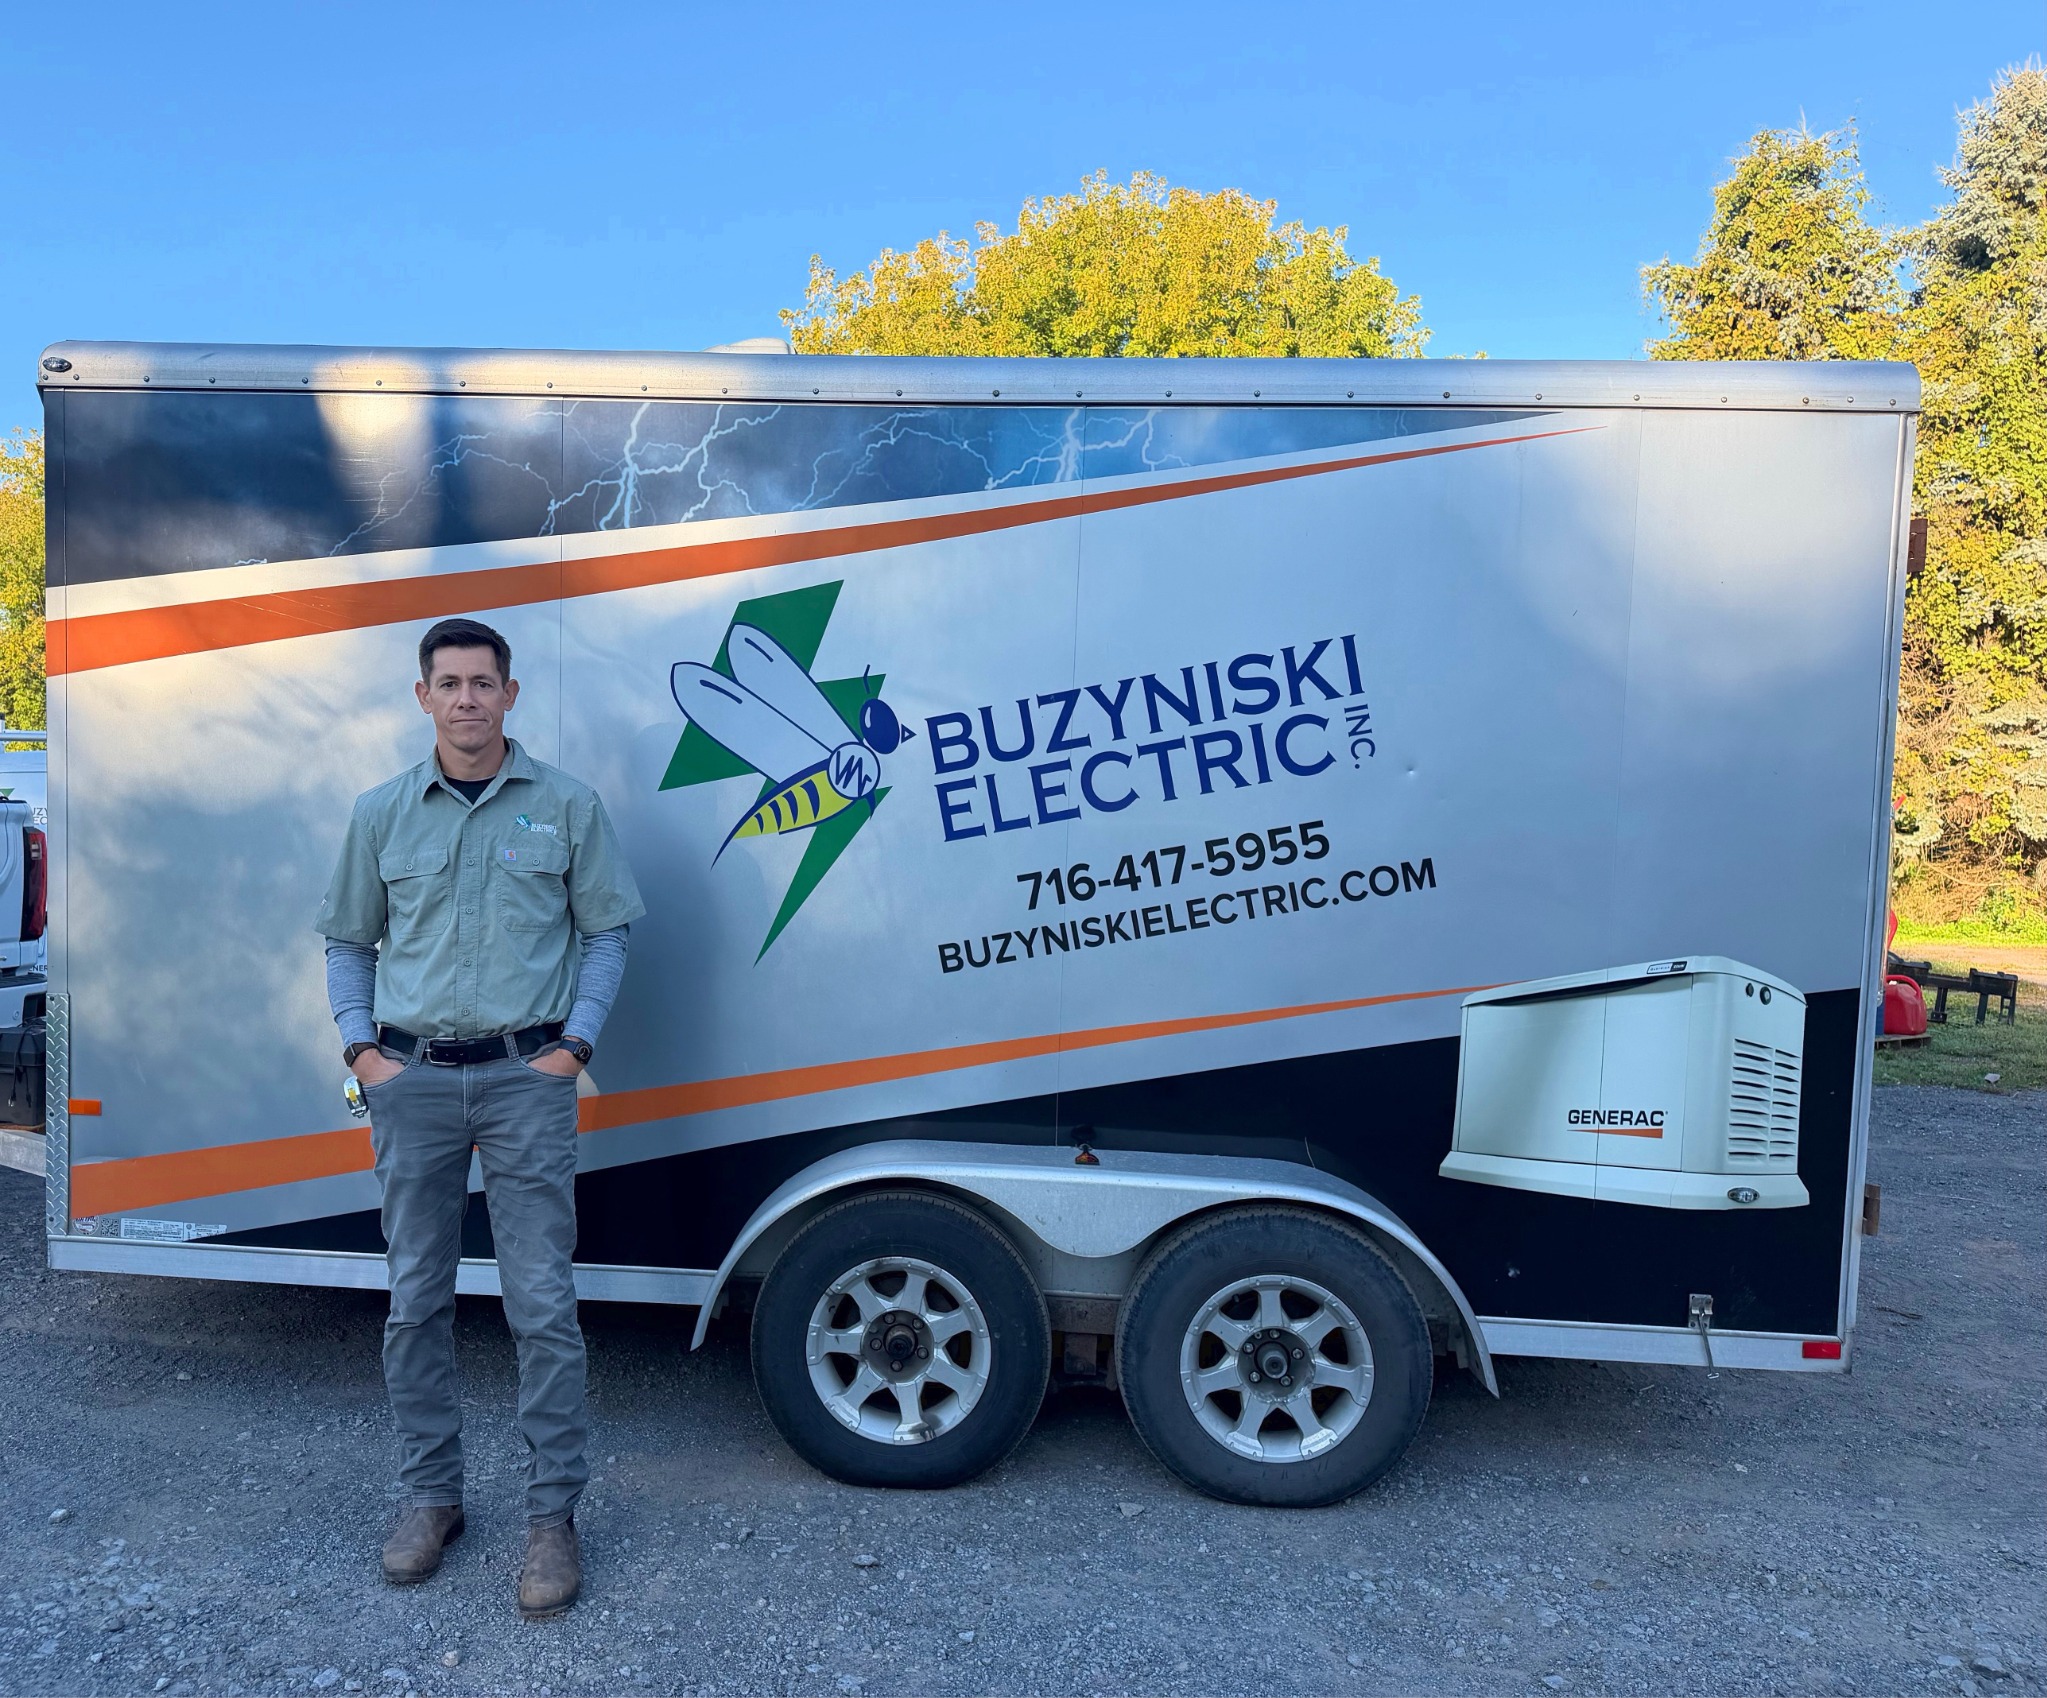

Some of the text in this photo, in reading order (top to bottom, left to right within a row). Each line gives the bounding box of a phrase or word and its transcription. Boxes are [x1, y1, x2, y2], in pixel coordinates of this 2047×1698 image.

[924, 633, 1366, 776] BUZYNISKI
[1343, 703, 1376, 770] INC.
[933, 713, 1337, 843] ELECTRIC
[937, 857, 1437, 974] BUZYNISKIELECTRIC.COM
[1016, 819, 1330, 911] 716-417-5955
[1567, 1109, 1665, 1127] GENERAC
